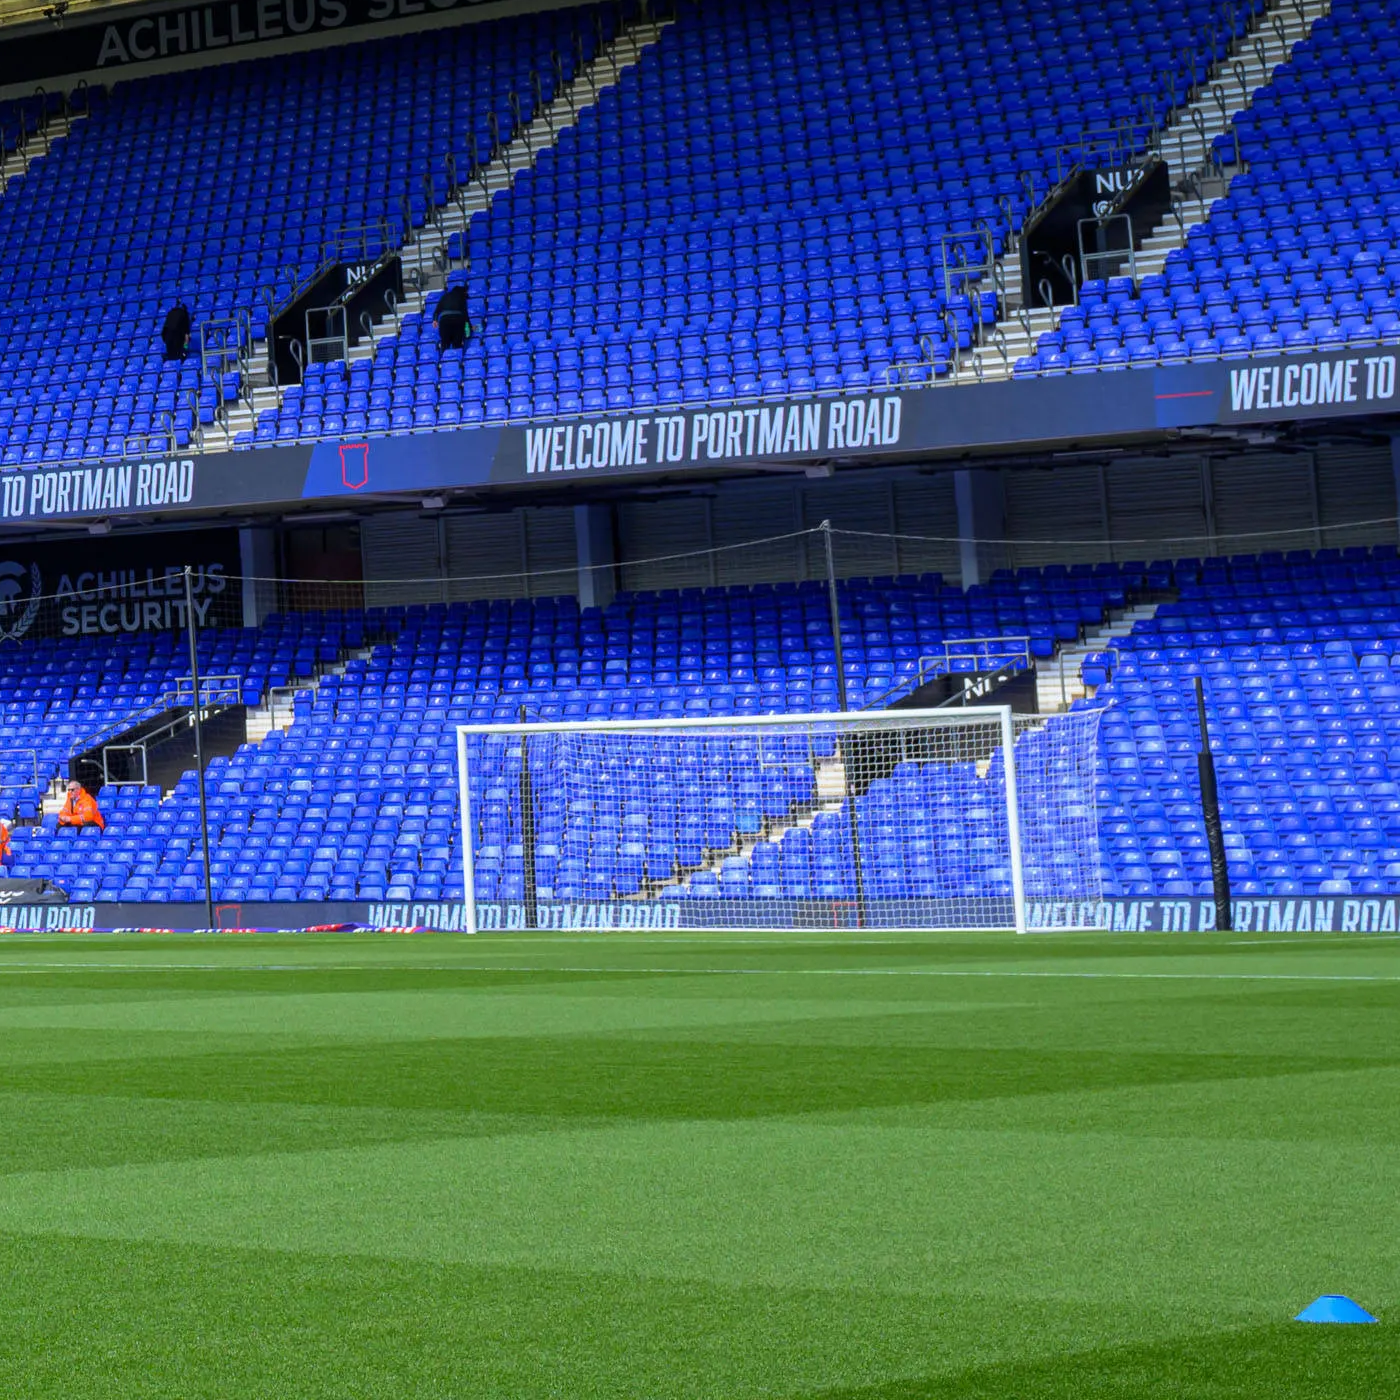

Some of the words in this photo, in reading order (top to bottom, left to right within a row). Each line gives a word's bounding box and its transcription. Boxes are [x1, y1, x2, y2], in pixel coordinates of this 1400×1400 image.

[1231, 359, 1358, 411] WELCOME
[1364, 354, 1396, 400] TO
[525, 419, 649, 473] WELCOME
[655, 416, 686, 463] TO
[692, 404, 822, 460] PORTMAN
[827, 396, 902, 448] ROAD
[2, 475, 25, 518] TO
[30, 465, 132, 515] PORTMAN
[137, 460, 194, 505] ROAD
[54, 562, 224, 602] ACHILLEUS
[46, 907, 95, 928] ROAD
[475, 904, 500, 928] TO
[618, 904, 679, 928] ROAD
[1023, 901, 1153, 932] WELCOME
[1159, 901, 1193, 932] TO
[1198, 901, 1331, 932] PRTMAN
